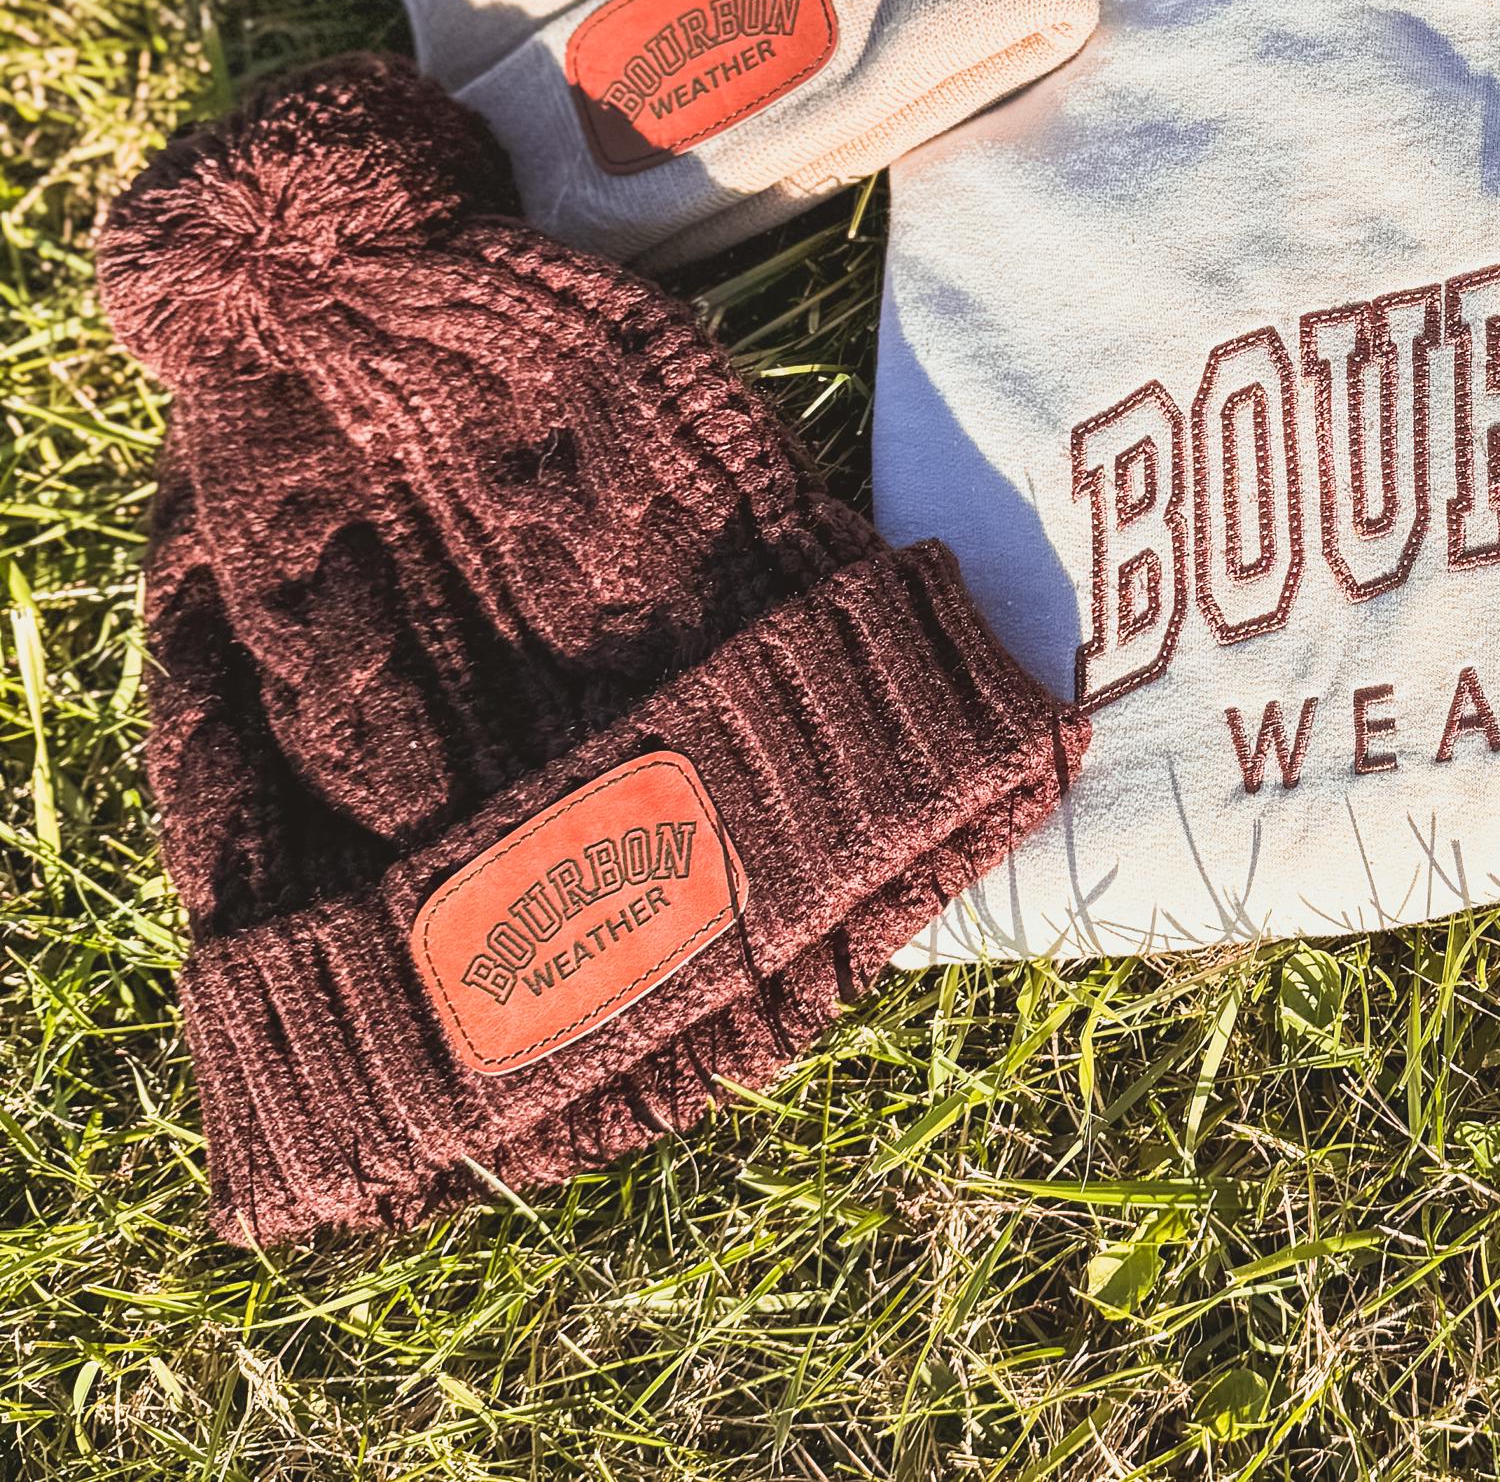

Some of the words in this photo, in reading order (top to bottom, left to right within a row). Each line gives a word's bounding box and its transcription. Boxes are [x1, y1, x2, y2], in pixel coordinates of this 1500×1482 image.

[648, 38, 777, 120] WEATHER
[461, 820, 697, 1005] BOURBON
[521, 886, 671, 996] WEATHER
